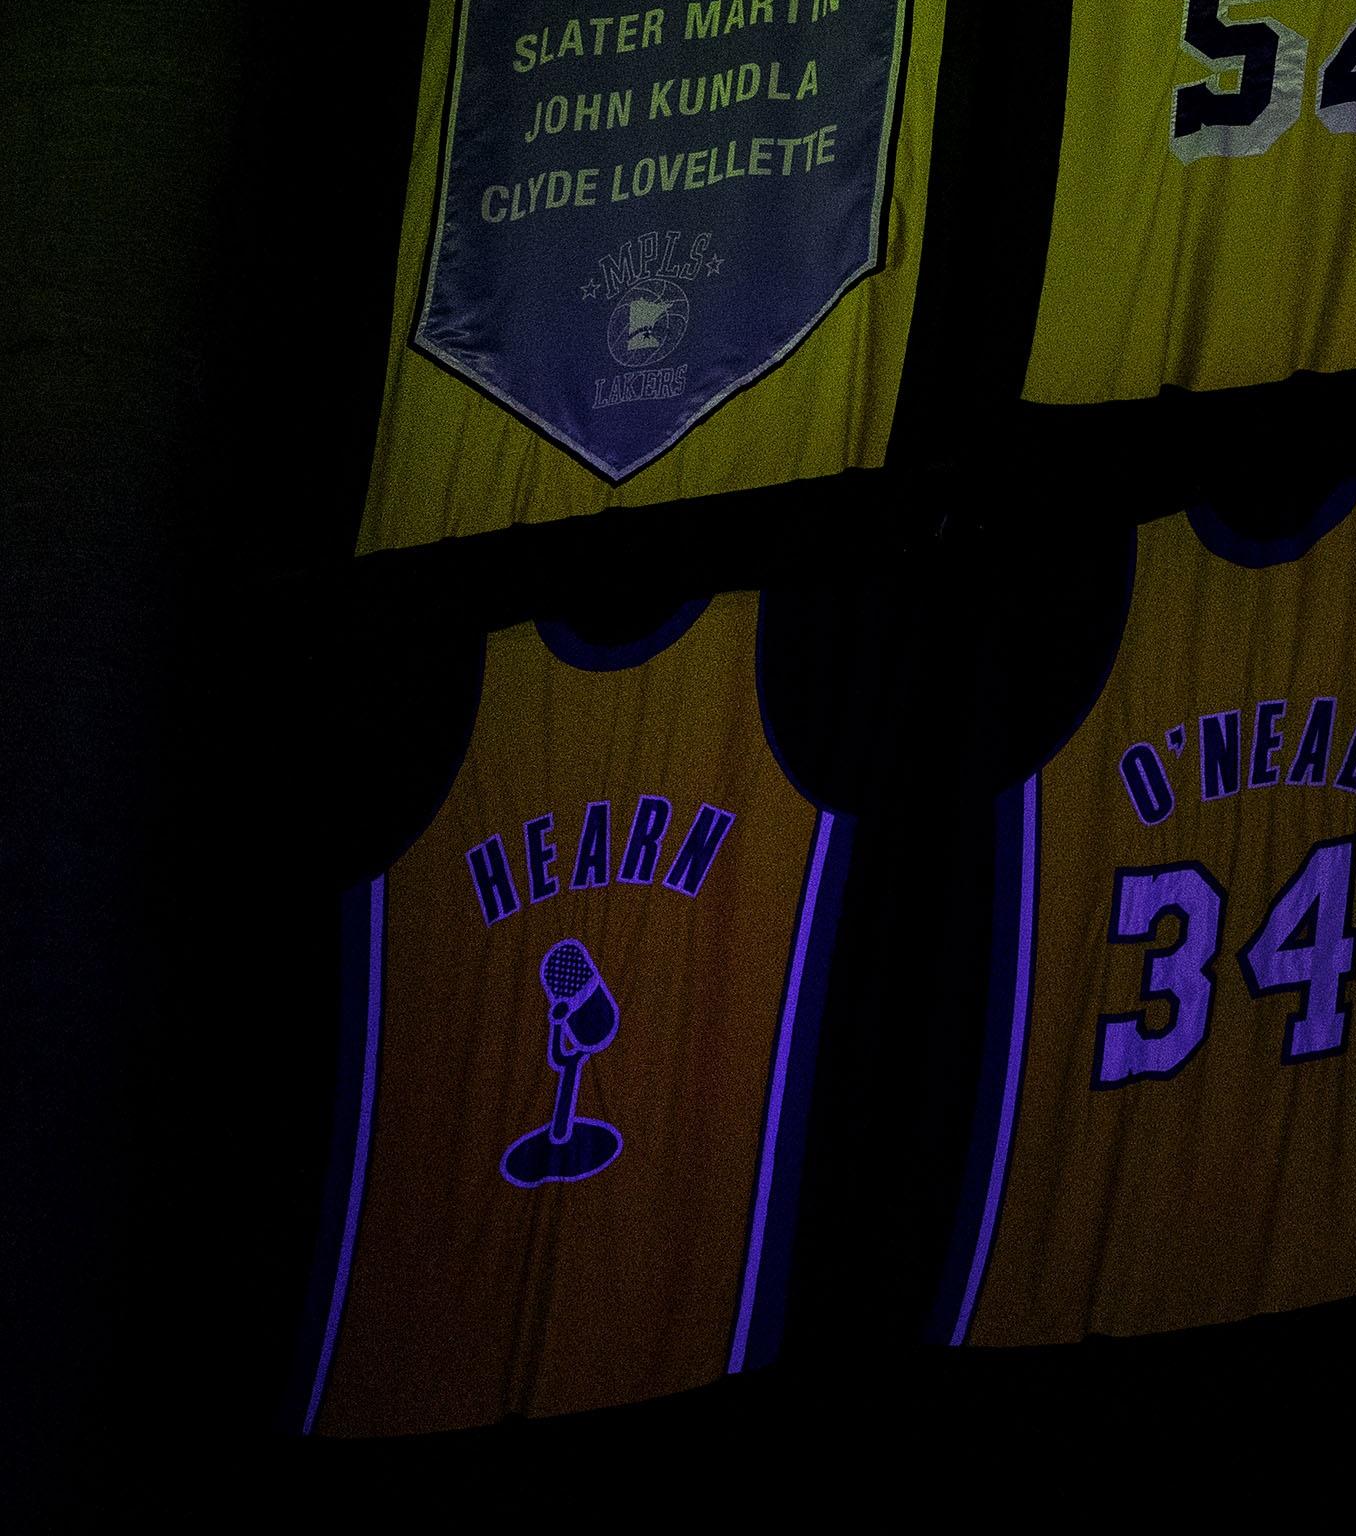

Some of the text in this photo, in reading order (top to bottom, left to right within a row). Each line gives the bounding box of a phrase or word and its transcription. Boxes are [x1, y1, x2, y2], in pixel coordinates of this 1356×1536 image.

[513, 8, 665, 72] SLATER
[524, 60, 820, 143] JOHN KUNDLA
[480, 124, 839, 224] CLYDE LOVELLETTE
[592, 364, 688, 409] LAKERS
[465, 794, 737, 928] HEARN
